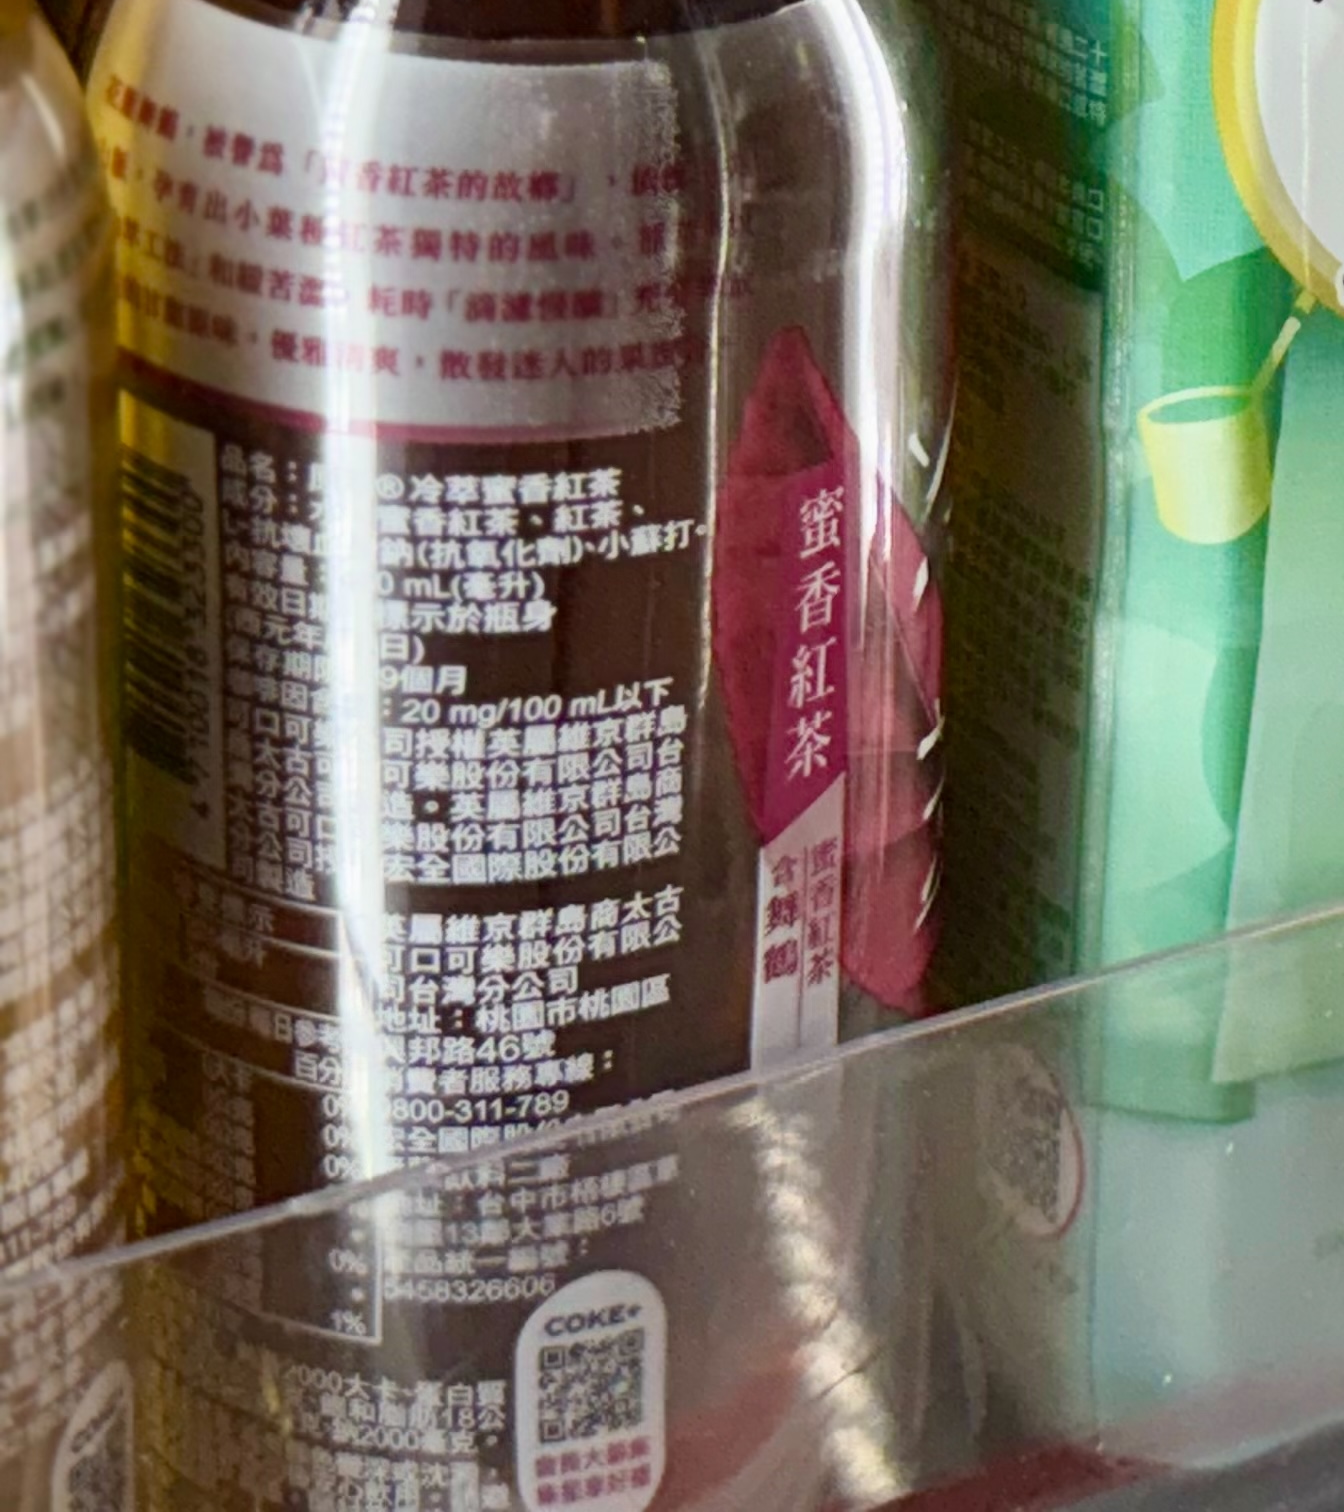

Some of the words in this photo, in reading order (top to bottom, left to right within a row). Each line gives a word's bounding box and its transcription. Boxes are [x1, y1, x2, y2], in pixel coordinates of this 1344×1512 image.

[787, 487, 843, 781] 蜜香紅茶
[808, 836, 838, 986] 蜜香紅茶
[543, 1303, 643, 1337] COKE+
